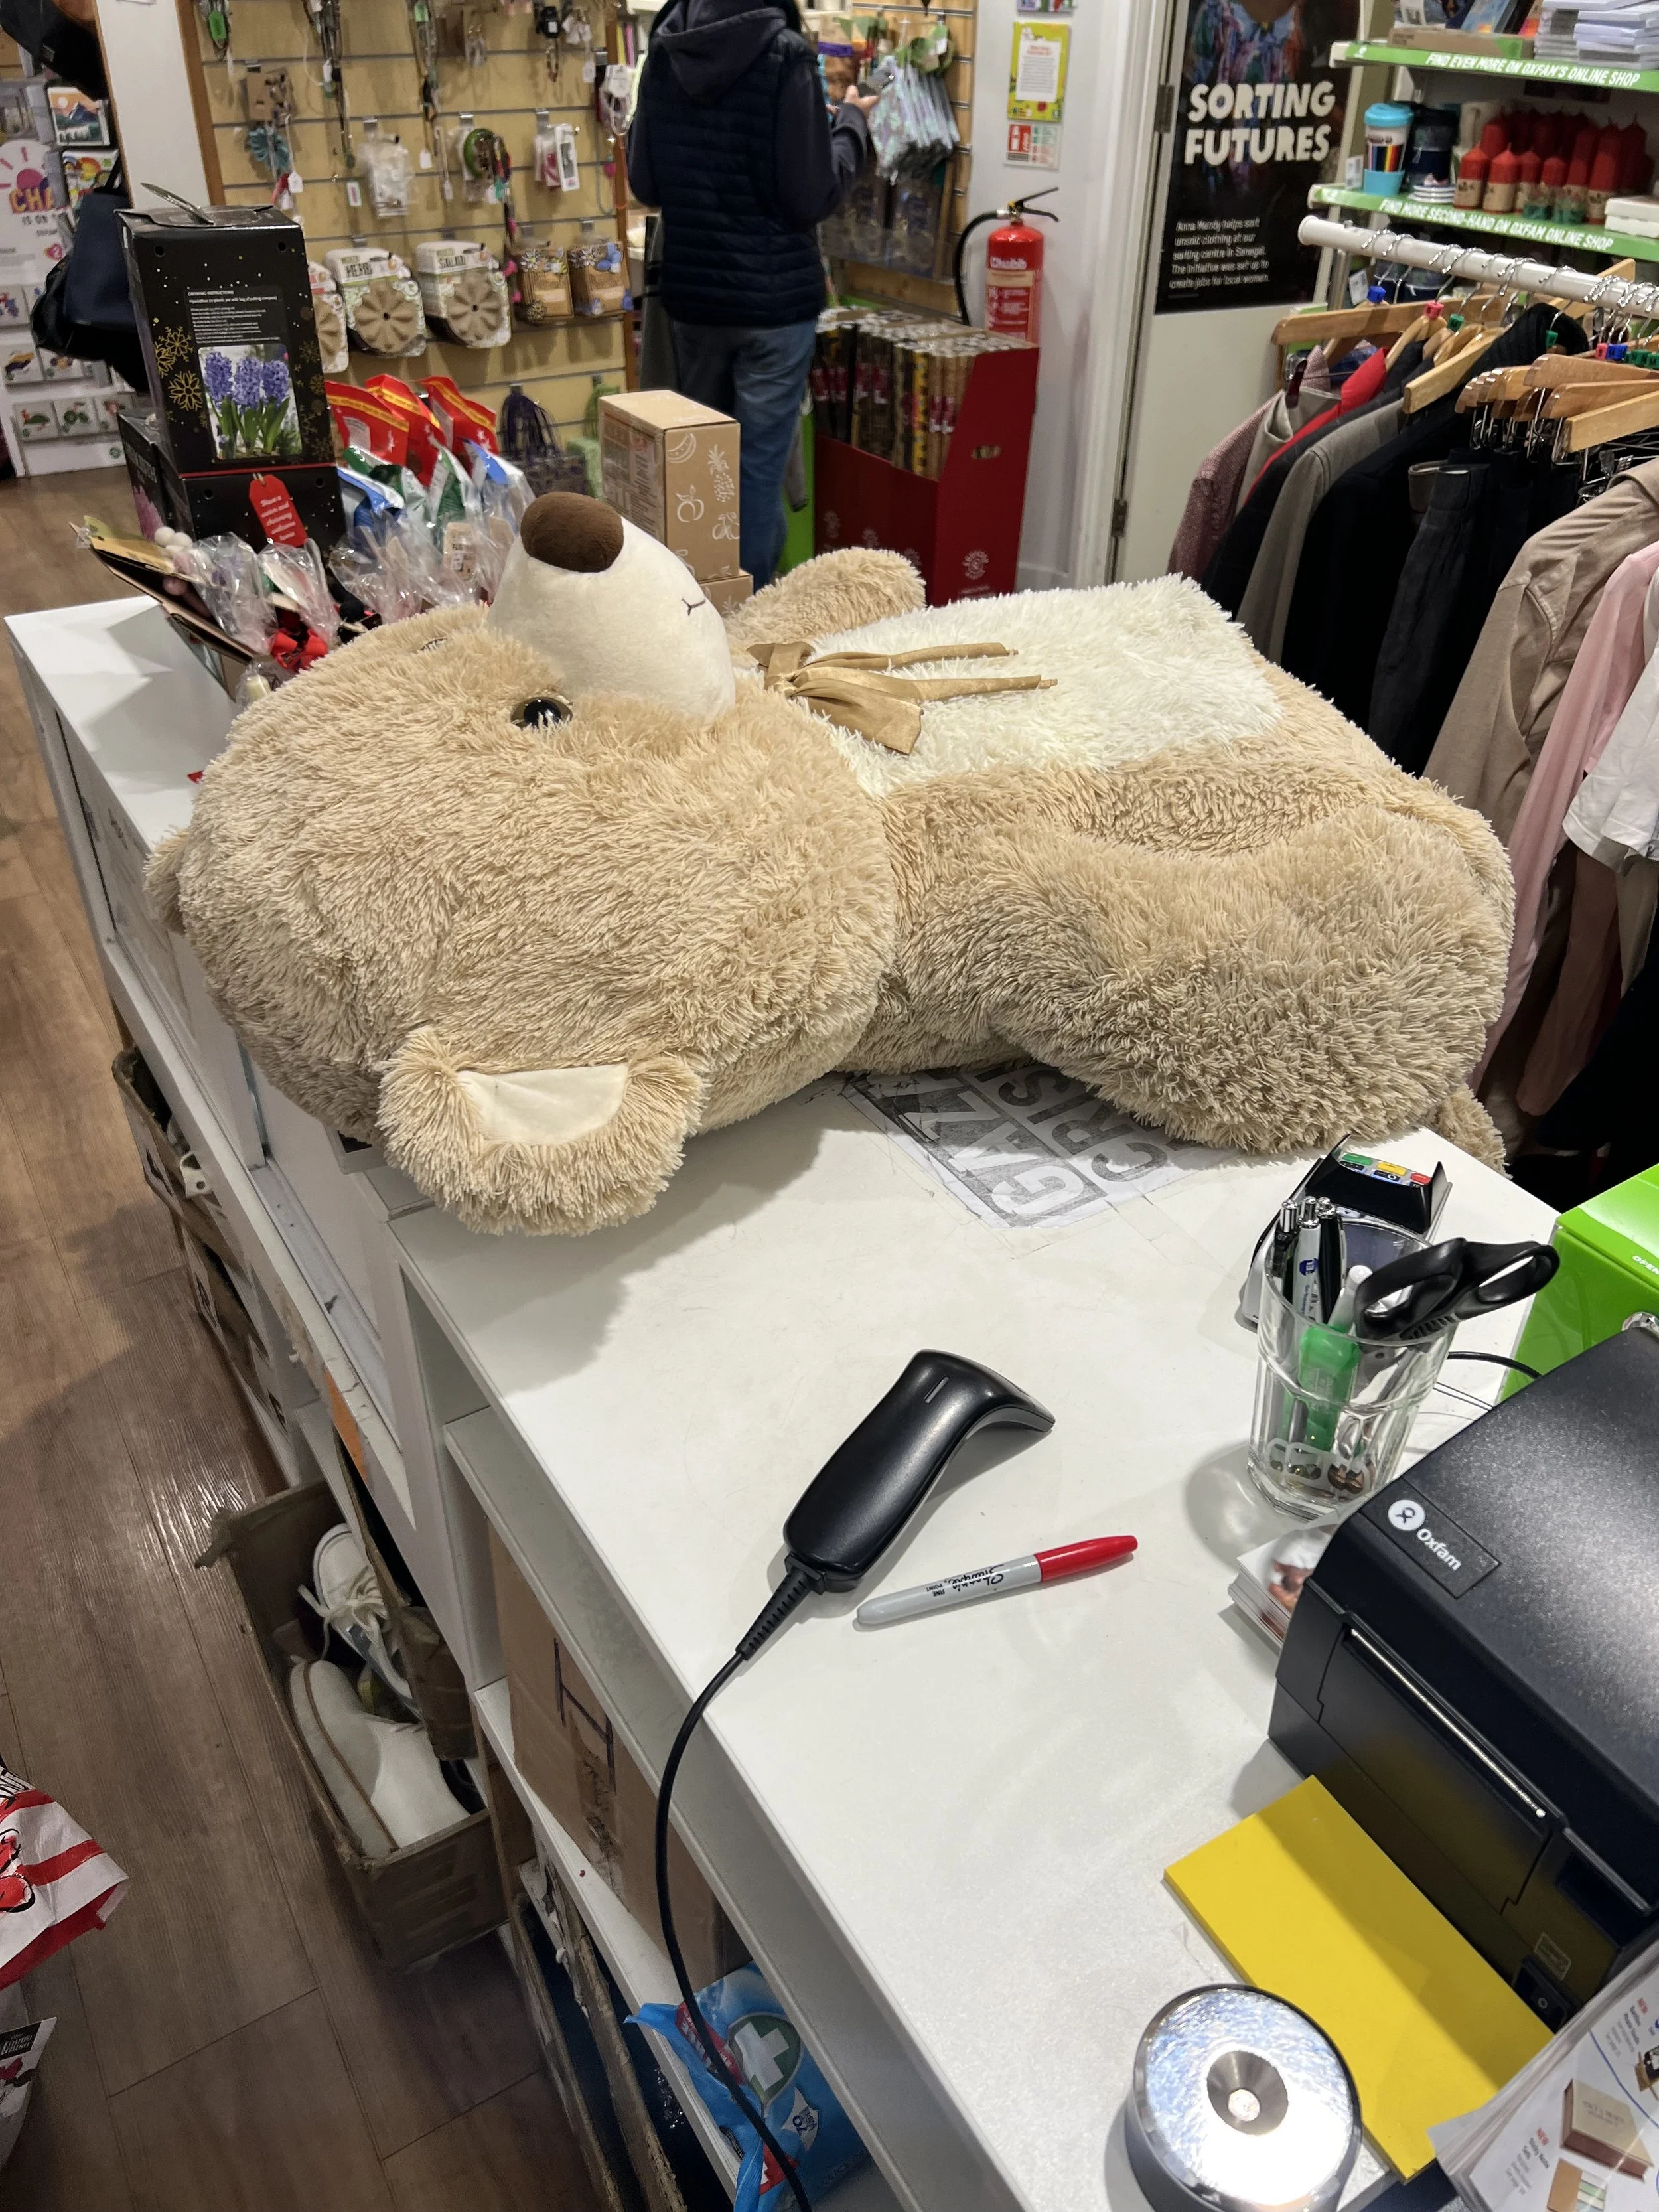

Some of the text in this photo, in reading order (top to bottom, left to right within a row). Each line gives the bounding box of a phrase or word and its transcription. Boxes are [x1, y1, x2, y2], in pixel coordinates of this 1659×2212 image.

[1425, 52, 1641, 87] FIND EVEN MORE ON OXFAM'S ONLINE SHOP
[1187, 80, 1336, 123] SORTING
[1184, 123, 1333, 166] FUTURES
[1222, 219, 1244, 230] helps
[1244, 216, 1260, 228] sort
[1378, 199, 1614, 251] FIND MORE SECOND-HAND ON OXFAM ONLINE SHOP
[1200, 233, 1232, 246] clothing
[1242, 233, 1256, 242] our
[1172, 250, 1200, 262] sorting
[1200, 248, 1226, 259] centre
[1227, 248, 1235, 257] in
[1171, 264, 1187, 275] The
[1187, 263, 1220, 274] initiative
[1236, 261, 1250, 270] set
[1250, 261, 1260, 272] up
[1260, 260, 1270, 269] to
[1169, 278, 1194, 289] create
[1417, 1528, 1461, 1570] Oxfam
[792, 2114, 809, 2136] 70
